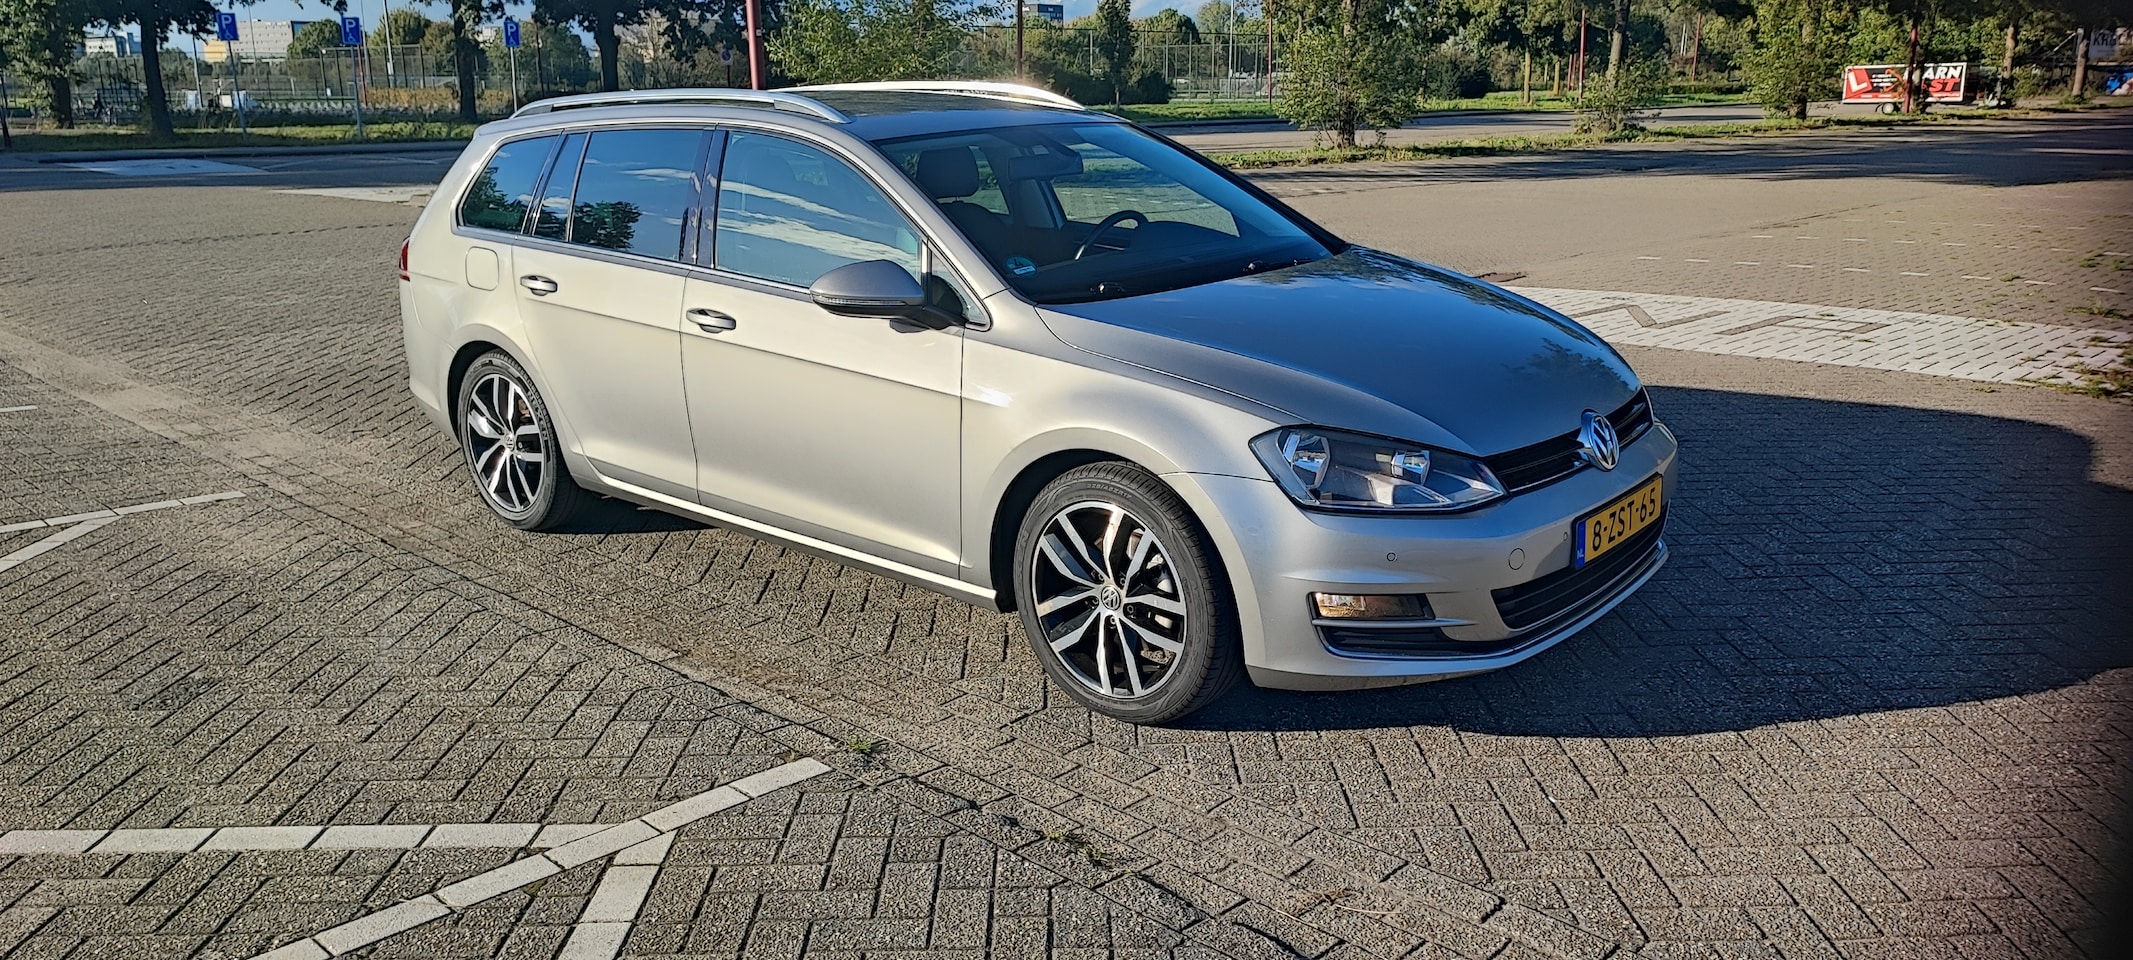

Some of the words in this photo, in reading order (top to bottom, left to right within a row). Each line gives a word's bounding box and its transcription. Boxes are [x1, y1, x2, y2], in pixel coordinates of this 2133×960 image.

[221, 15, 232, 29] P
[346, 19, 356, 33] P
[507, 23, 516, 36] P
[1592, 487, 1656, 552] 8-ZST-65
